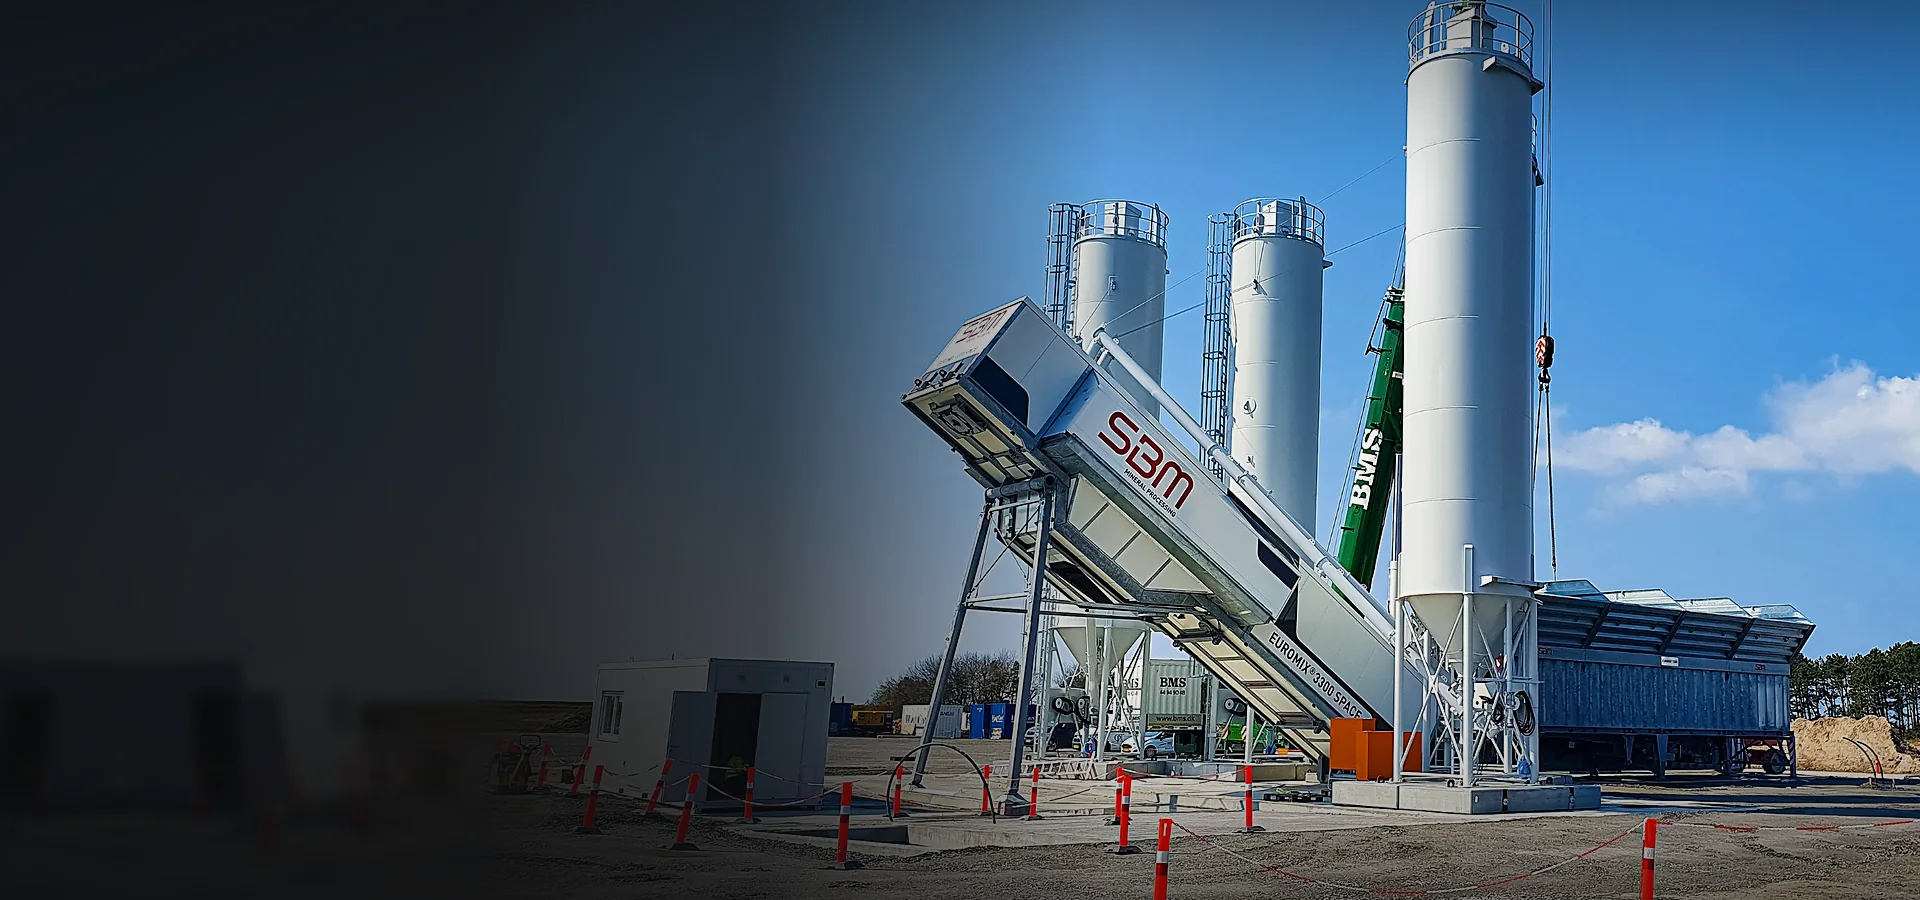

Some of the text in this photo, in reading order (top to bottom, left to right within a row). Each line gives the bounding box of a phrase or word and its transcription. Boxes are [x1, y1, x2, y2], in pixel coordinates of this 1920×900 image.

[1349, 428, 1383, 511] BMS
[1123, 468, 1177, 517] MINERAL PROCESSING
[1160, 677, 1187, 688] BMS
[1312, 672, 1335, 697] 3300
